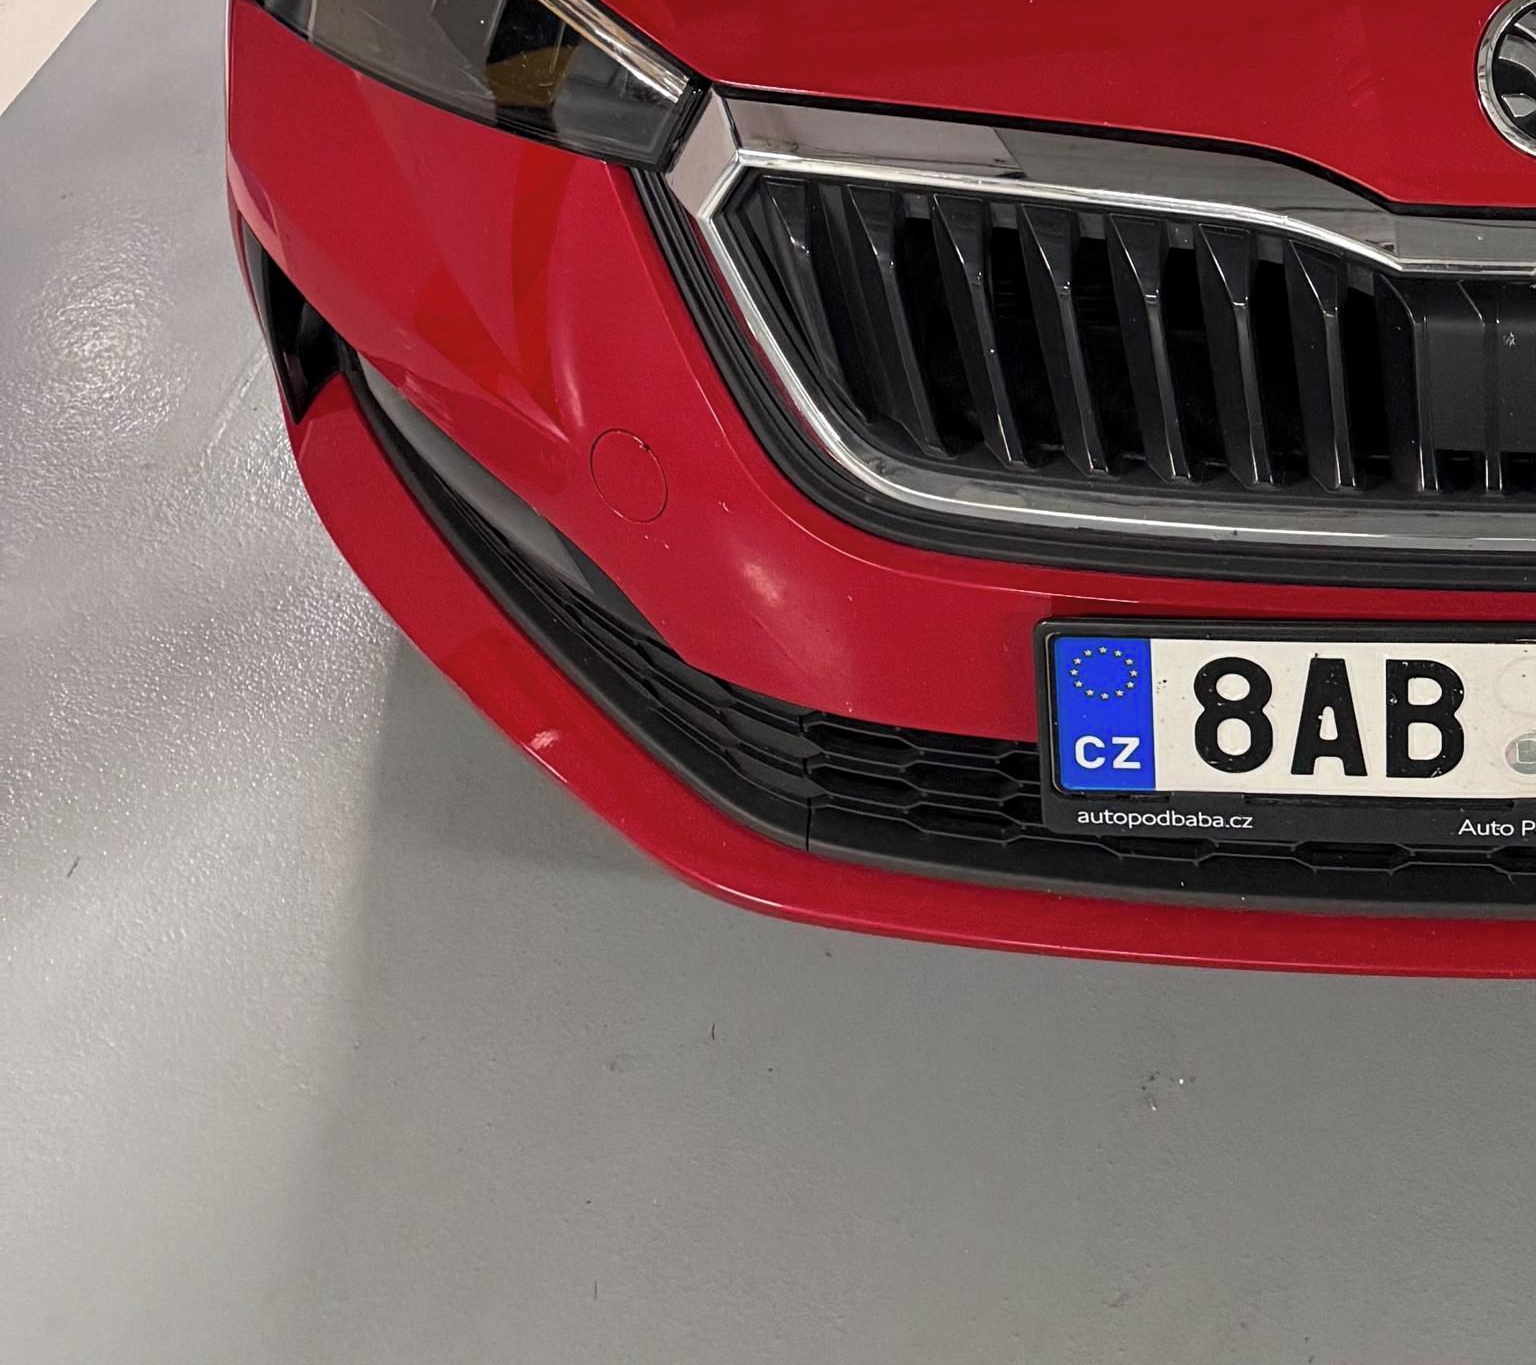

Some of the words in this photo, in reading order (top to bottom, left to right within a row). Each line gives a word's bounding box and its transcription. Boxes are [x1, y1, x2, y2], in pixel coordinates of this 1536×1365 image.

[1193, 656, 1465, 779] 8AB
[1074, 735, 1142, 770] CZ
[1077, 809, 1254, 830] autopodbaba.cz
[1457, 818, 1515, 837] Auto
